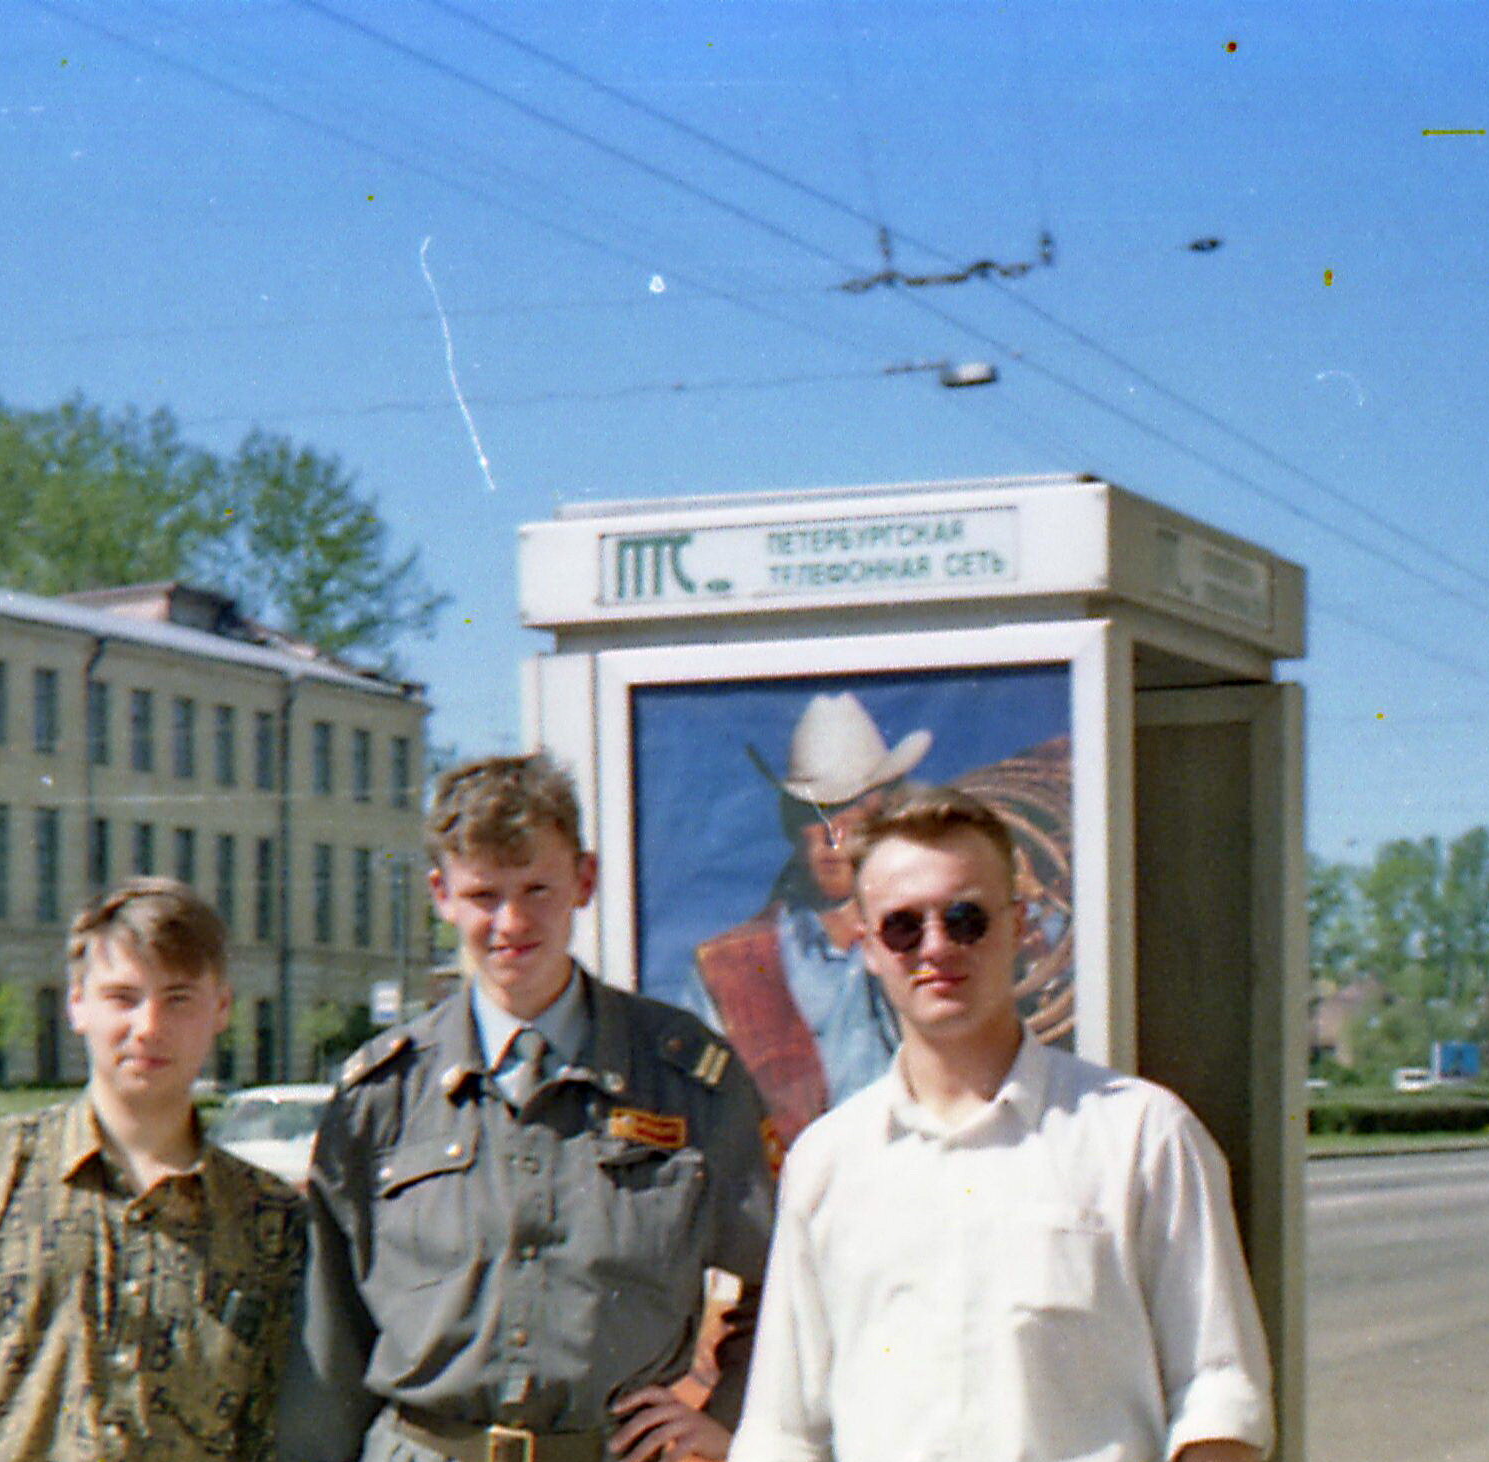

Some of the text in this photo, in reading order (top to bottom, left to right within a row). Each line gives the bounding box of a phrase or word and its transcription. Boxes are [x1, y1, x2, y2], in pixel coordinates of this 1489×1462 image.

[767, 519, 965, 556] ПЕТЕРБУРГСКАЯ
[769, 549, 1007, 587] ТЕЛЕФОННАЯ СЕТЬ
